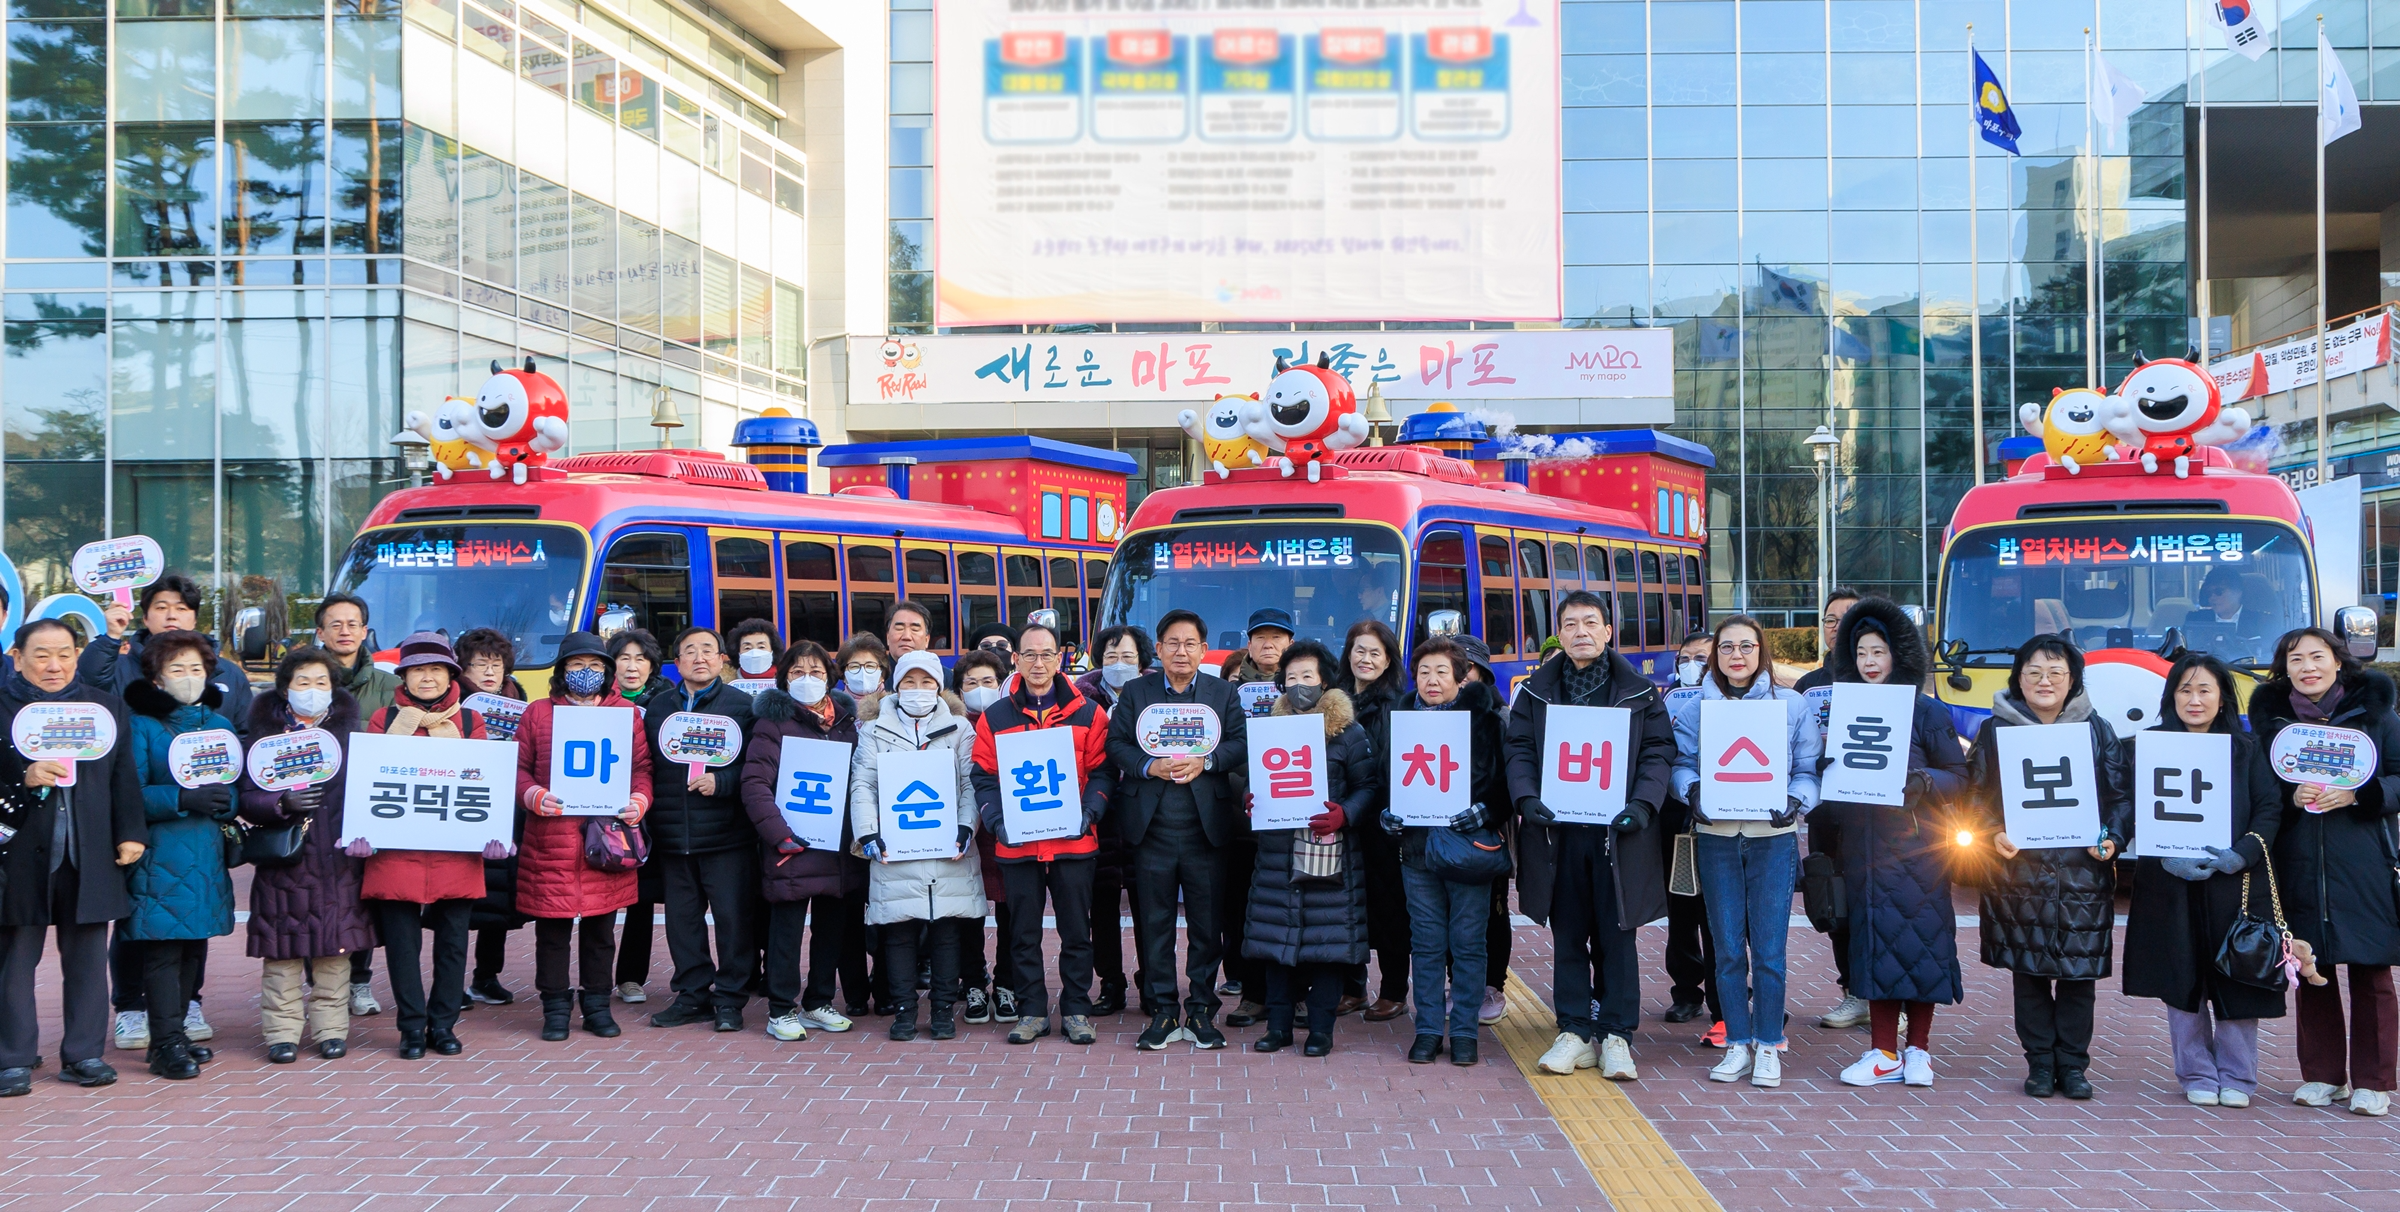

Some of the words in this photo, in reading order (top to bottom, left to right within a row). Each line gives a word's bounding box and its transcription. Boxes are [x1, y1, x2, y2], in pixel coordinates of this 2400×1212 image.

[2348, 328, 2362, 344] 근무
[876, 373, 902, 400] Red
[975, 343, 1112, 392] 새로운
[1131, 342, 1231, 392] 마포
[1419, 340, 1516, 390] 마포
[1580, 373, 1595, 382] my
[1597, 372, 1627, 382] mapo
[180, 734, 228, 745] 마포순환열차버스
[260, 733, 321, 748] 마포순환열차버스
[675, 716, 730, 727] 마포순환열차버스
[1842, 716, 1893, 770] 홍
[2292, 728, 2360, 742] 마포순환열차버스
[380, 766, 456, 777] 마포순환열차버스
[564, 738, 619, 784] 마
[1262, 744, 1315, 799] 열
[1401, 743, 1460, 793] 차
[1557, 740, 1612, 791] 버
[1713, 736, 1774, 783] 스
[2022, 756, 2079, 809] 보
[369, 782, 491, 822] 공덕동
[785, 771, 833, 815] 포
[891, 780, 945, 830] 순
[1011, 758, 1066, 812] 환
[2154, 767, 2213, 823] 단
